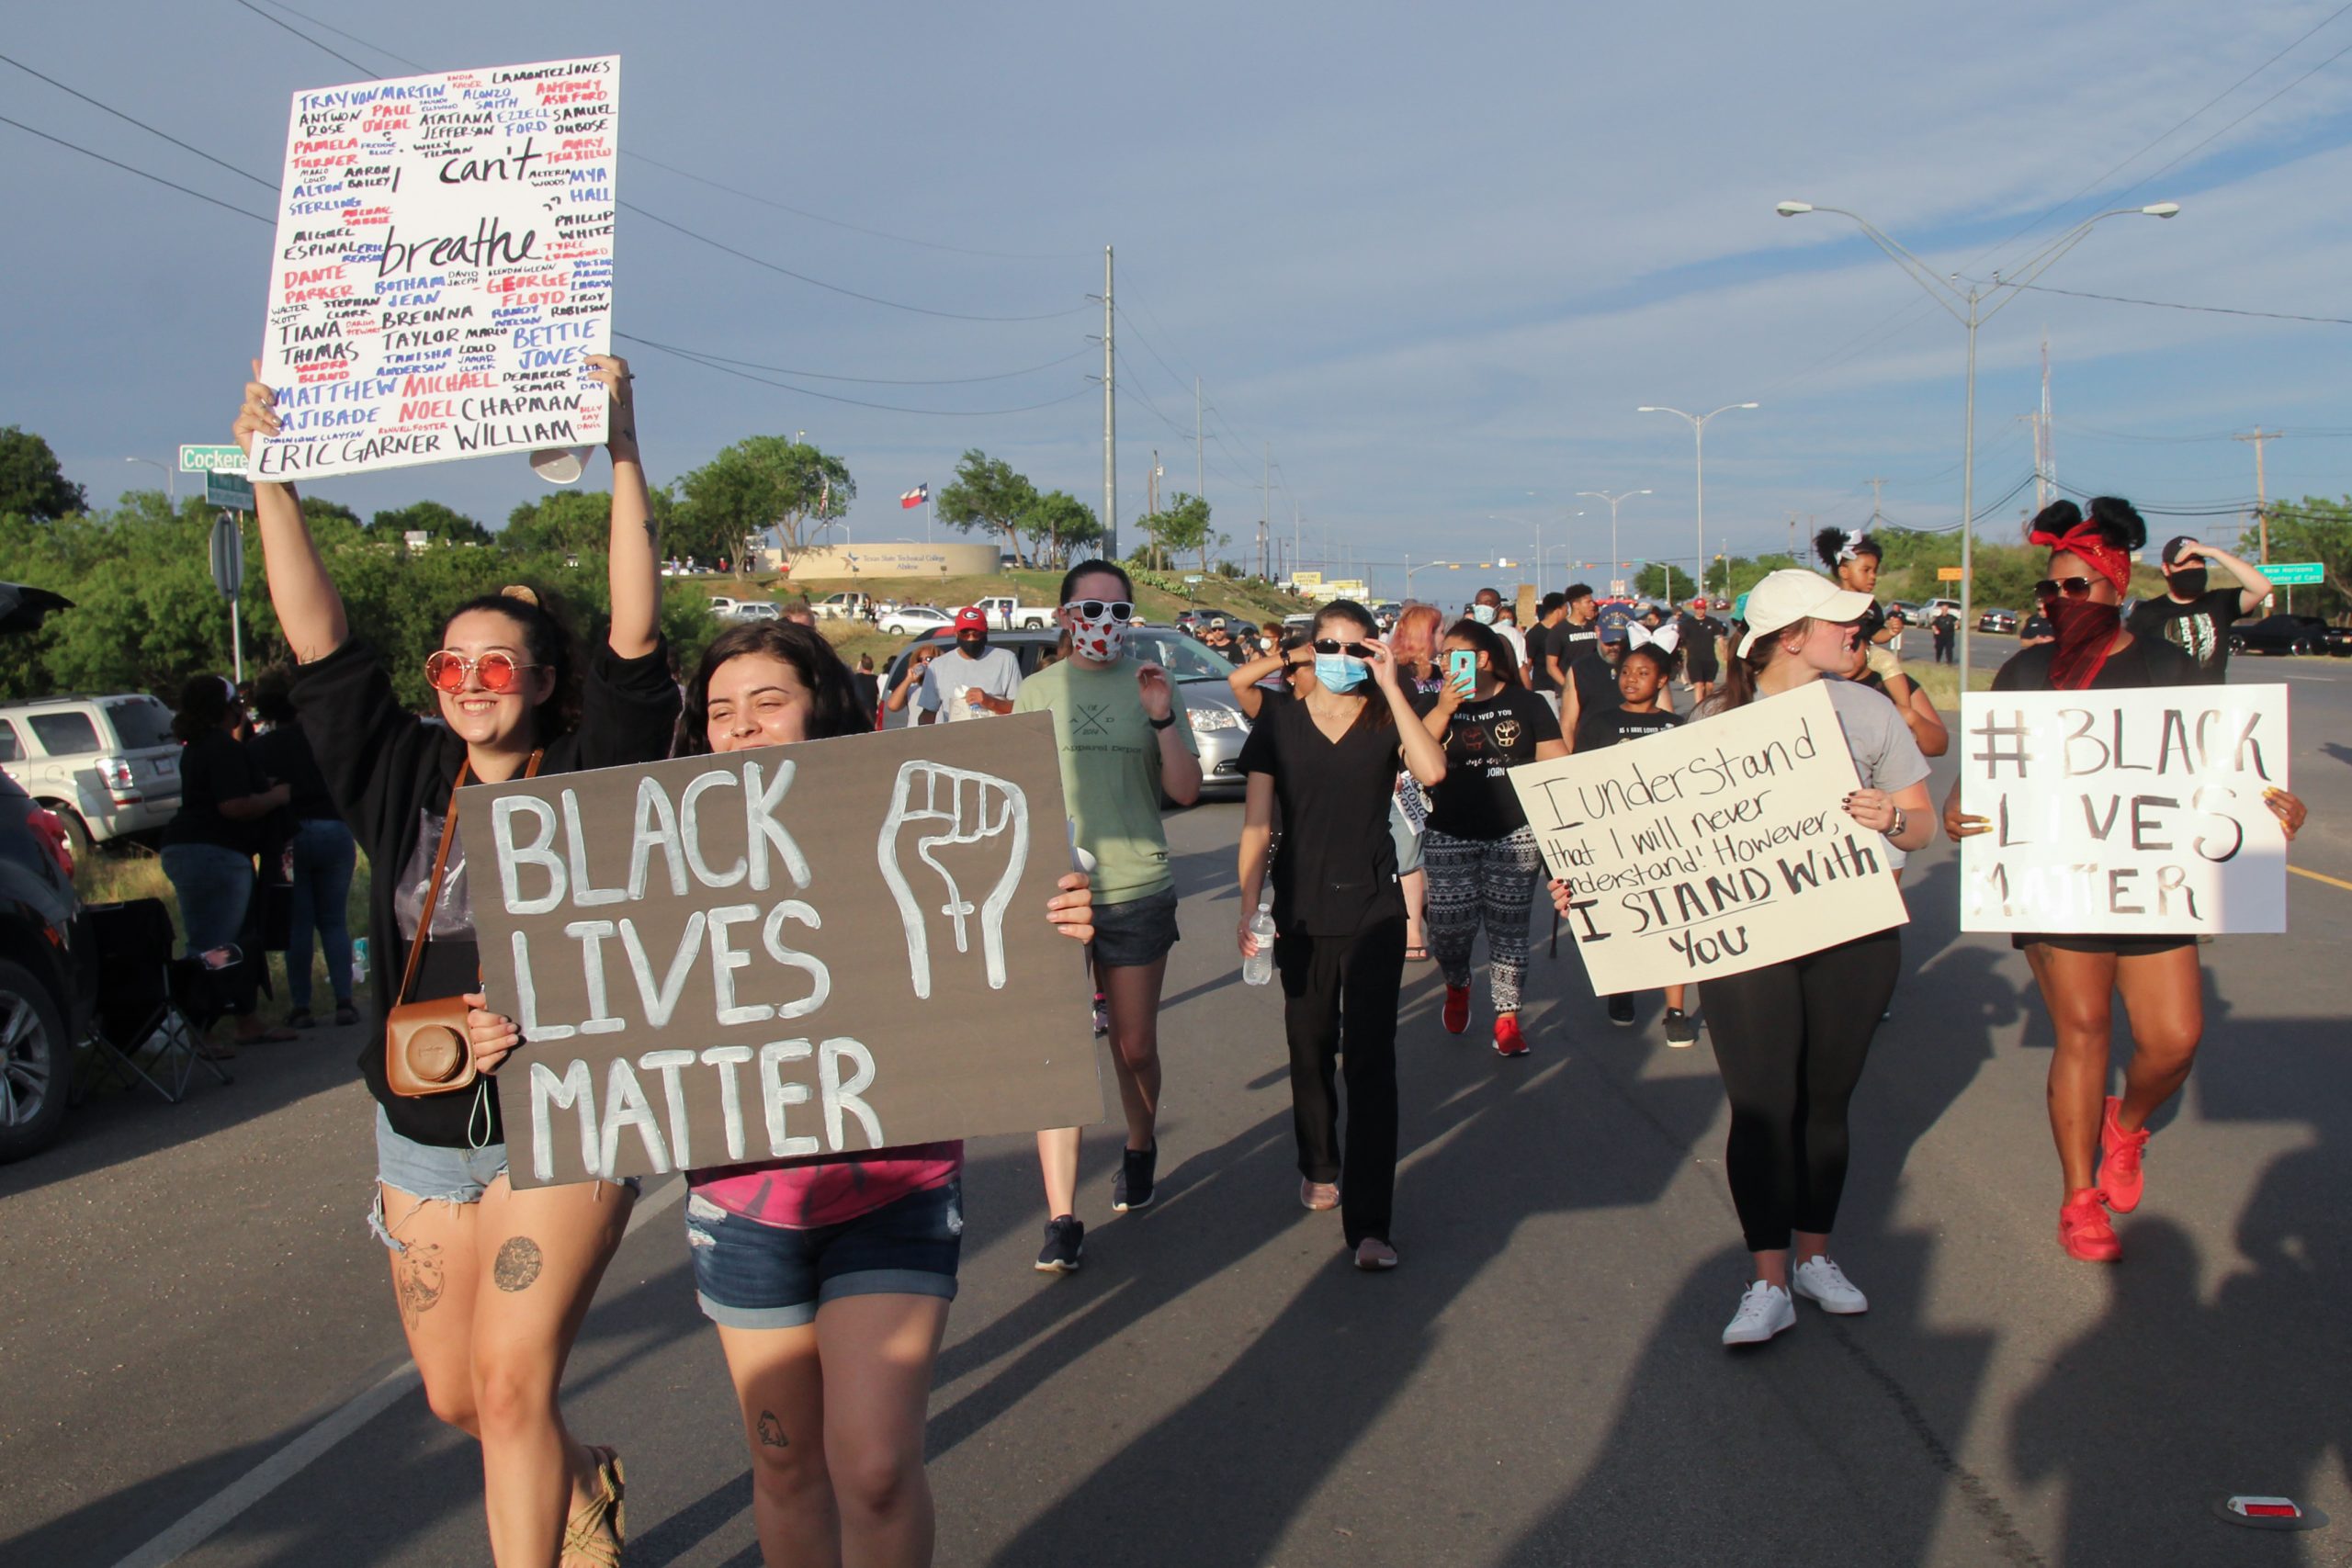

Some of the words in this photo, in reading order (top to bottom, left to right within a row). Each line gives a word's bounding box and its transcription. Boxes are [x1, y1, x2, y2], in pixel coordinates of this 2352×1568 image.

[492, 67, 563, 85] LAMONTEZ
[566, 61, 611, 76] JONES
[300, 87, 379, 111] TRAYVON
[380, 84, 446, 101] MARTIN
[462, 87, 512, 100] ALONZO
[541, 90, 608, 107] ASHFORD
[372, 104, 416, 117] PAUL
[475, 96, 519, 110] SMITH
[299, 108, 362, 127] ANTWON
[419, 111, 494, 127] ATATIANA
[553, 104, 617, 121] SAMUEL
[306, 122, 345, 138] ROSE
[421, 125, 495, 140] JEFFERSON
[504, 120, 548, 137] FORD
[293, 138, 358, 154] PAMELA
[561, 137, 605, 151] MARY
[290, 153, 359, 169] TURNER
[344, 165, 390, 178] AARON
[569, 167, 608, 185] MYA
[292, 181, 344, 198] ALTON
[347, 176, 390, 188] BAILEY
[570, 186, 613, 203] HALL
[288, 197, 362, 216] STERLING
[555, 210, 615, 227] PHILLIP
[292, 228, 356, 244] MIGUEL
[559, 224, 614, 240] WHITE
[284, 241, 357, 260] ESPINAL
[284, 263, 349, 289] DANTE
[375, 276, 446, 294] BOTHAM
[487, 271, 571, 294] GEORGE
[285, 285, 355, 304] PARKER
[388, 290, 441, 307] JEAN
[501, 289, 566, 308] FLOYD
[570, 292, 605, 302] TROY
[327, 309, 372, 320] CLARK
[279, 321, 342, 345] TIANA
[382, 328, 459, 350] TAYLOR
[513, 318, 601, 349] BETTIE
[279, 341, 359, 365] THOMAS
[382, 347, 453, 364] TANISHA
[458, 344, 496, 355] LOUD
[299, 370, 349, 384] BLAND
[401, 372, 500, 399] MICHAEL
[580, 381, 604, 390] DAY
[276, 377, 398, 409] MATTHEW
[399, 399, 457, 423] NOEL
[462, 393, 582, 422] CHAPMAN
[279, 407, 381, 432] AJIBADE
[321, 430, 365, 441] CLAYTON
[454, 420, 578, 450] WILLIAM
[259, 443, 335, 474] ERIC
[342, 434, 441, 463] GARNER
[1487, 767, 1506, 777] JOHN
[1529, 775, 1585, 832] I
[492, 759, 811, 915] BLACK
[1546, 838, 1597, 870] that
[1610, 828, 1624, 860] I
[1632, 814, 1681, 855] will
[1690, 788, 1772, 837] never
[1566, 846, 1707, 897] nderstand!
[1569, 898, 1611, 944] I
[1621, 865, 1772, 935] STAND
[1668, 923, 1748, 968] YOU
[512, 898, 831, 1043] LIVES
[530, 1037, 885, 1181] MATTER
